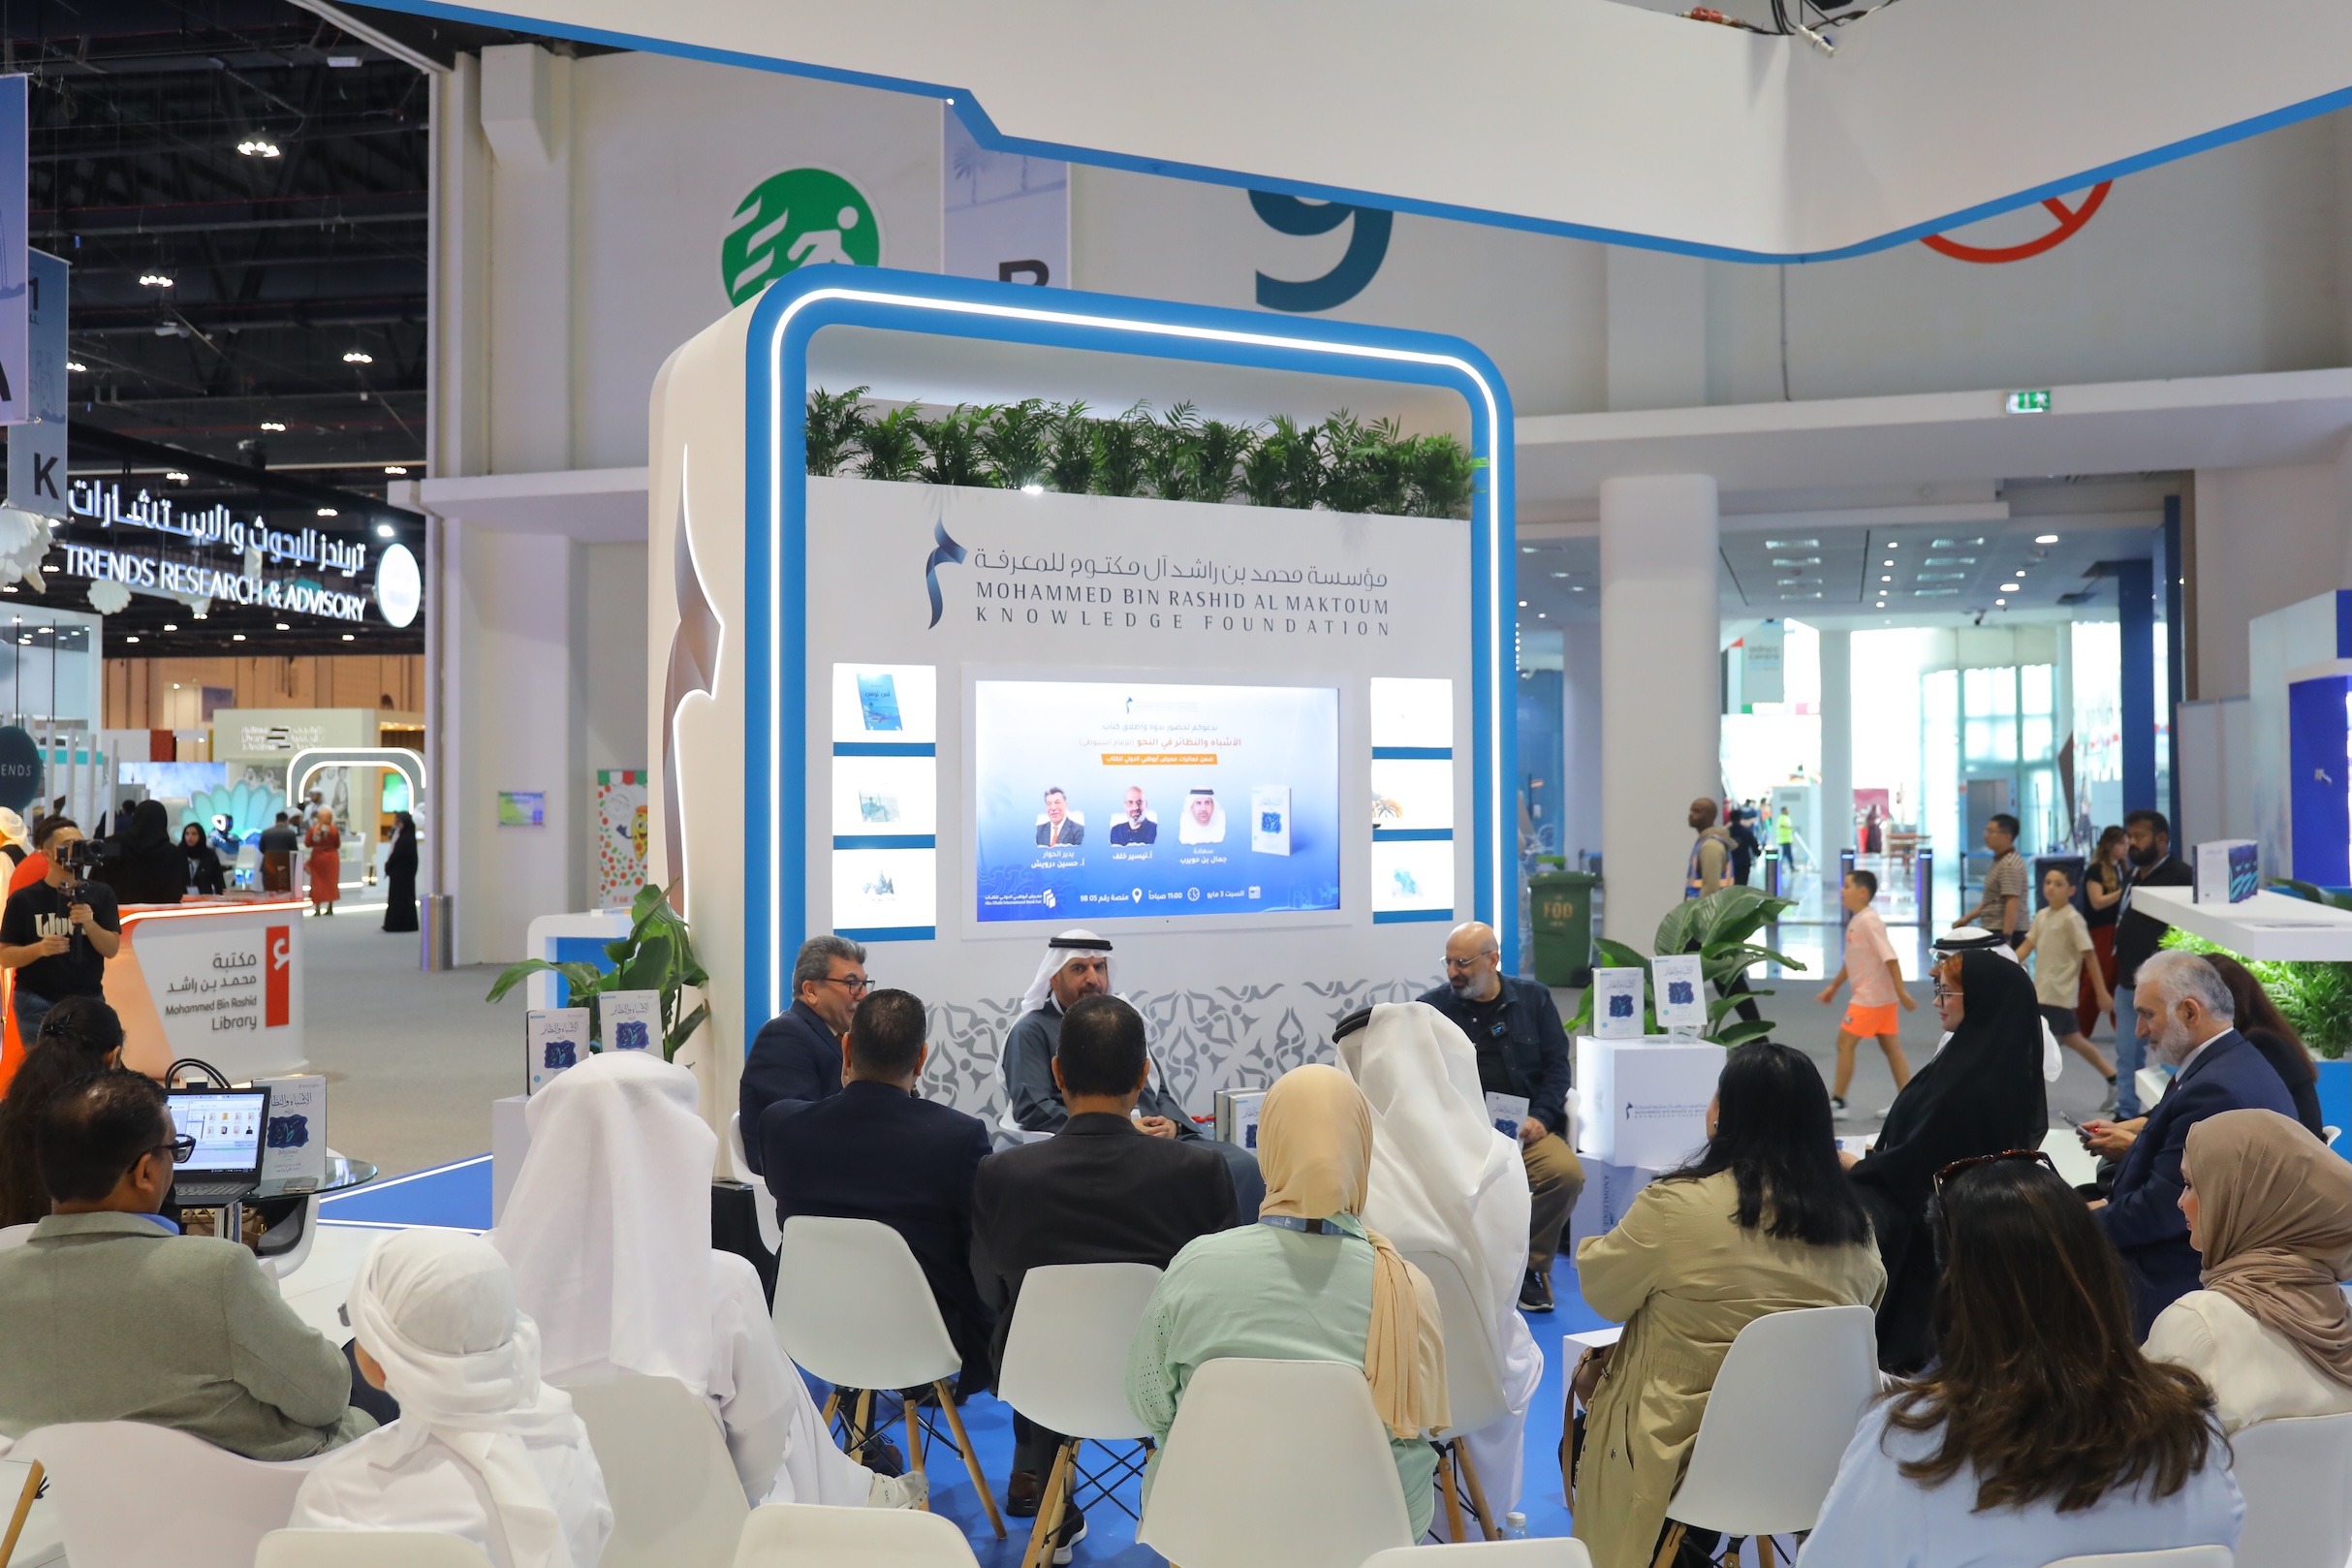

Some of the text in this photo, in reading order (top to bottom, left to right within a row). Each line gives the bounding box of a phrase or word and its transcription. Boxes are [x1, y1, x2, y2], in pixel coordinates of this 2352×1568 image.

[34, 452, 59, 500] K
[67, 479, 366, 578] تريندز للبحوث والاستشارات
[63, 543, 367, 622] TRENDS RESEARCH & ADVISORY
[974, 548, 1388, 592] مؤسسة محمد بن راشد آل مكتوم للمعرفة
[976, 580, 1389, 615] MOHAMMED BIN RASHID AL MAKTOUM
[976, 606, 1389, 637] KNOWLEDGE FOUNDATION
[1, 764, 32, 776] ENDS
[212, 952, 258, 973] مكتبة
[167, 974, 257, 994] محمد بن راشد
[165, 994, 258, 1017] Mohammed Bin Rashid
[211, 1015, 258, 1031] Library
